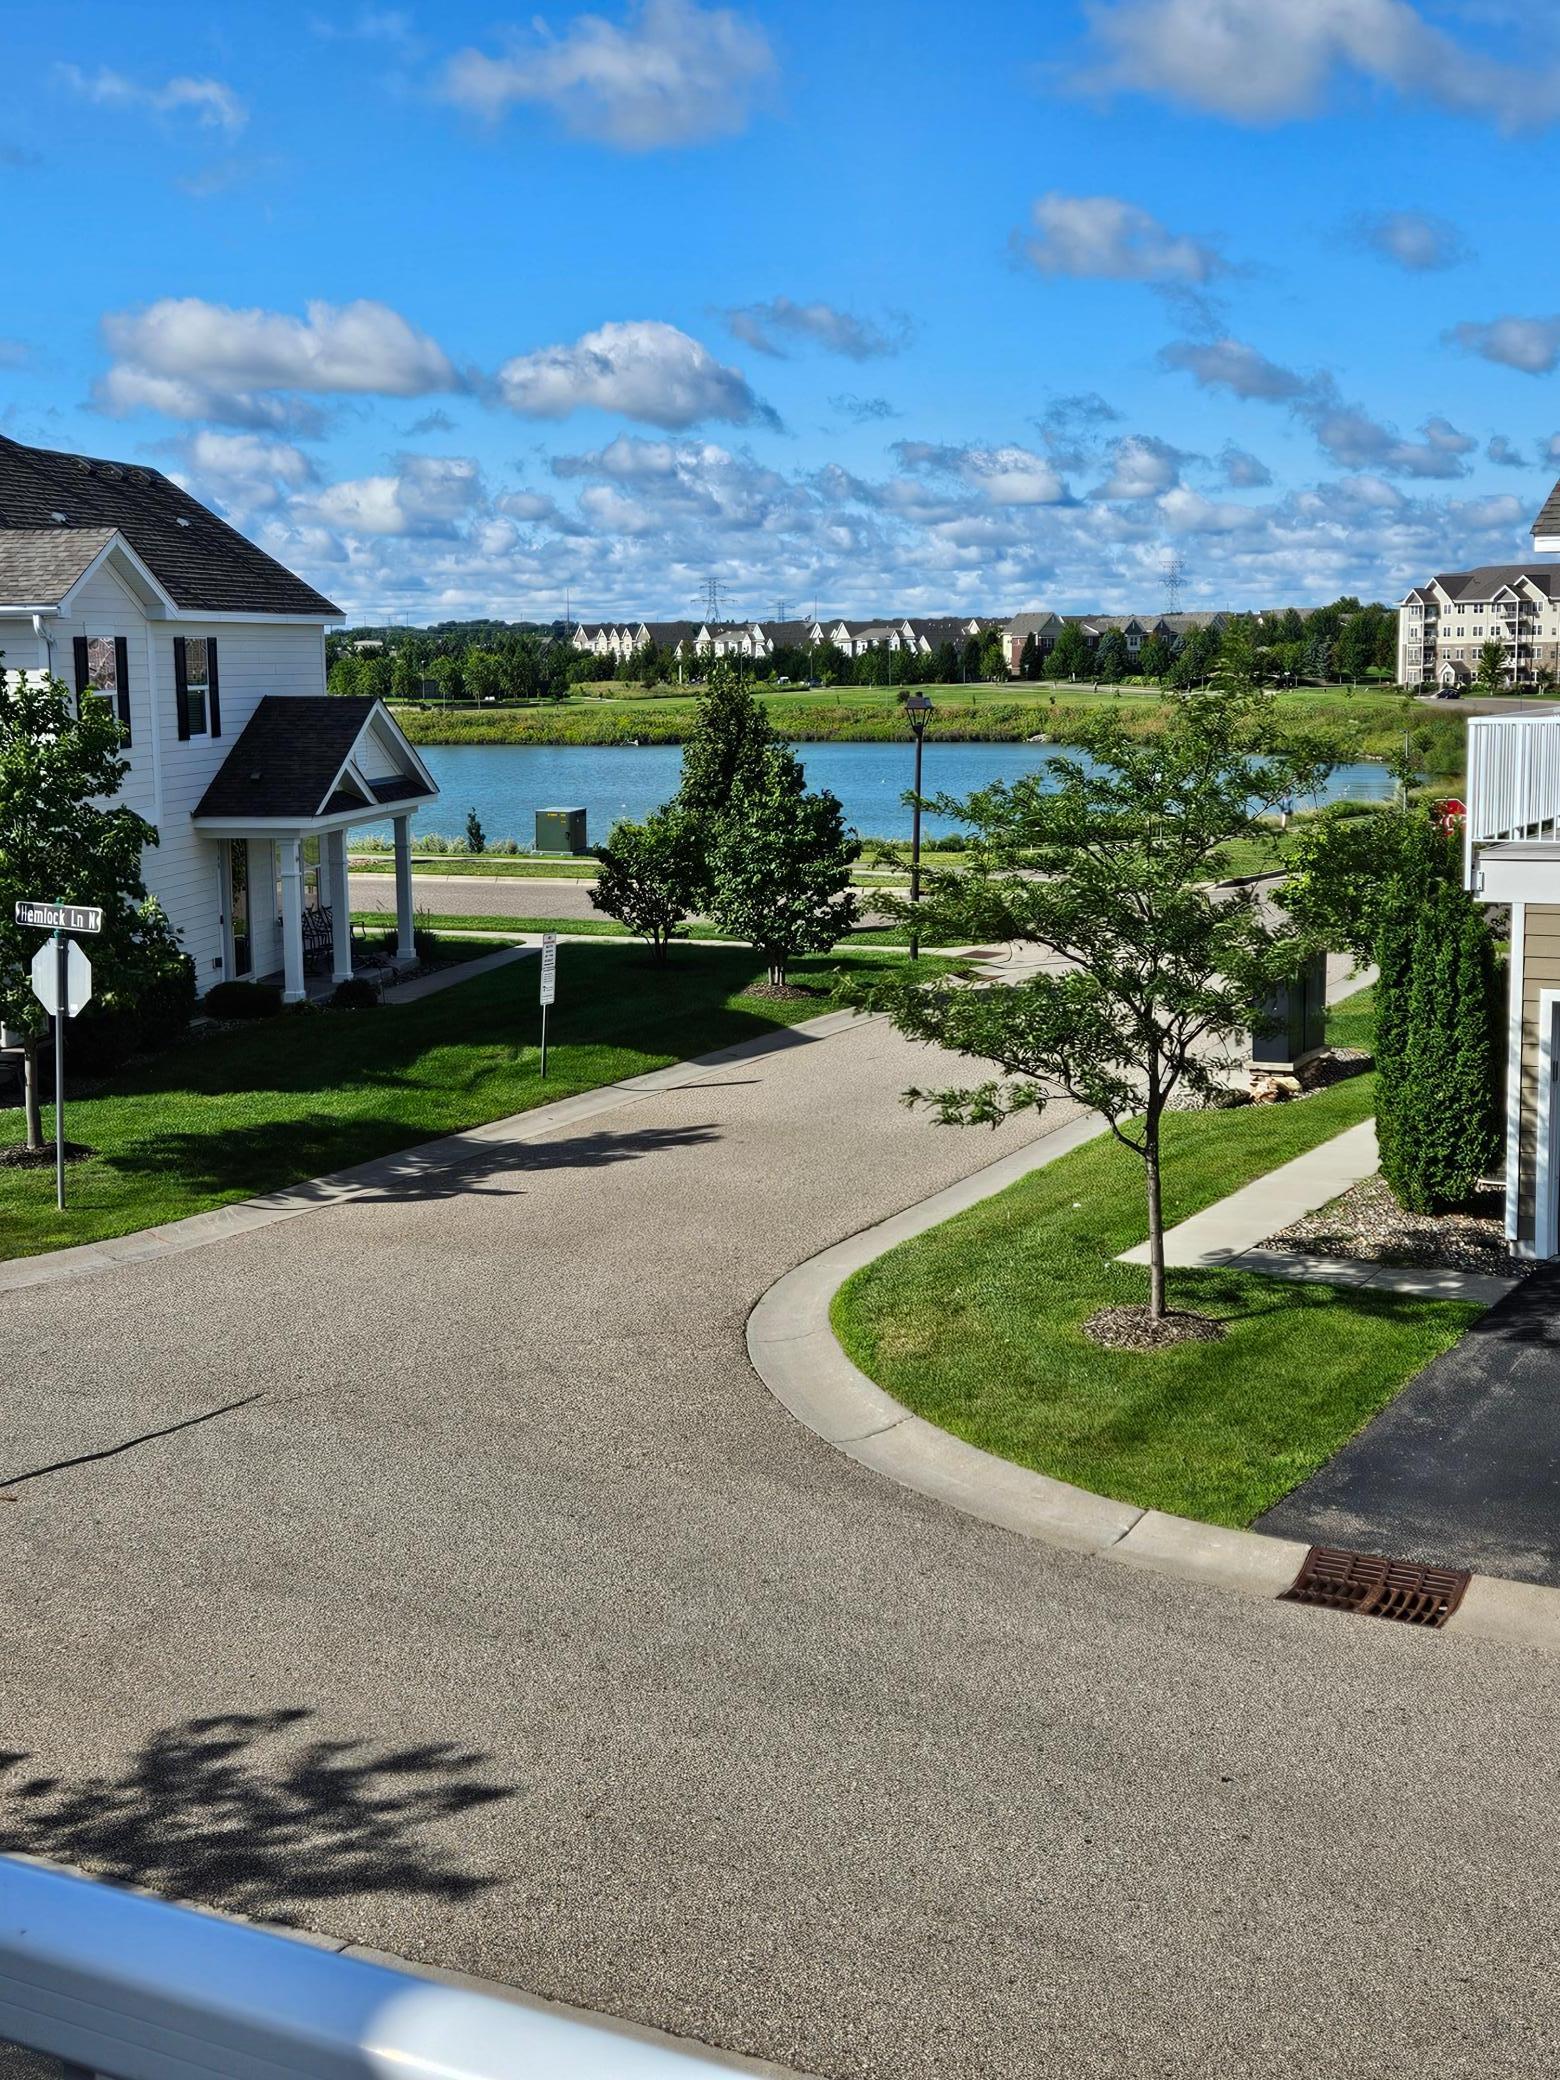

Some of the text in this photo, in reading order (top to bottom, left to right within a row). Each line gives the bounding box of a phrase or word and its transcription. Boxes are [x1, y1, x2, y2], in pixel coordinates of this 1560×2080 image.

[21, 904, 96, 930] Hemlock Ln N
